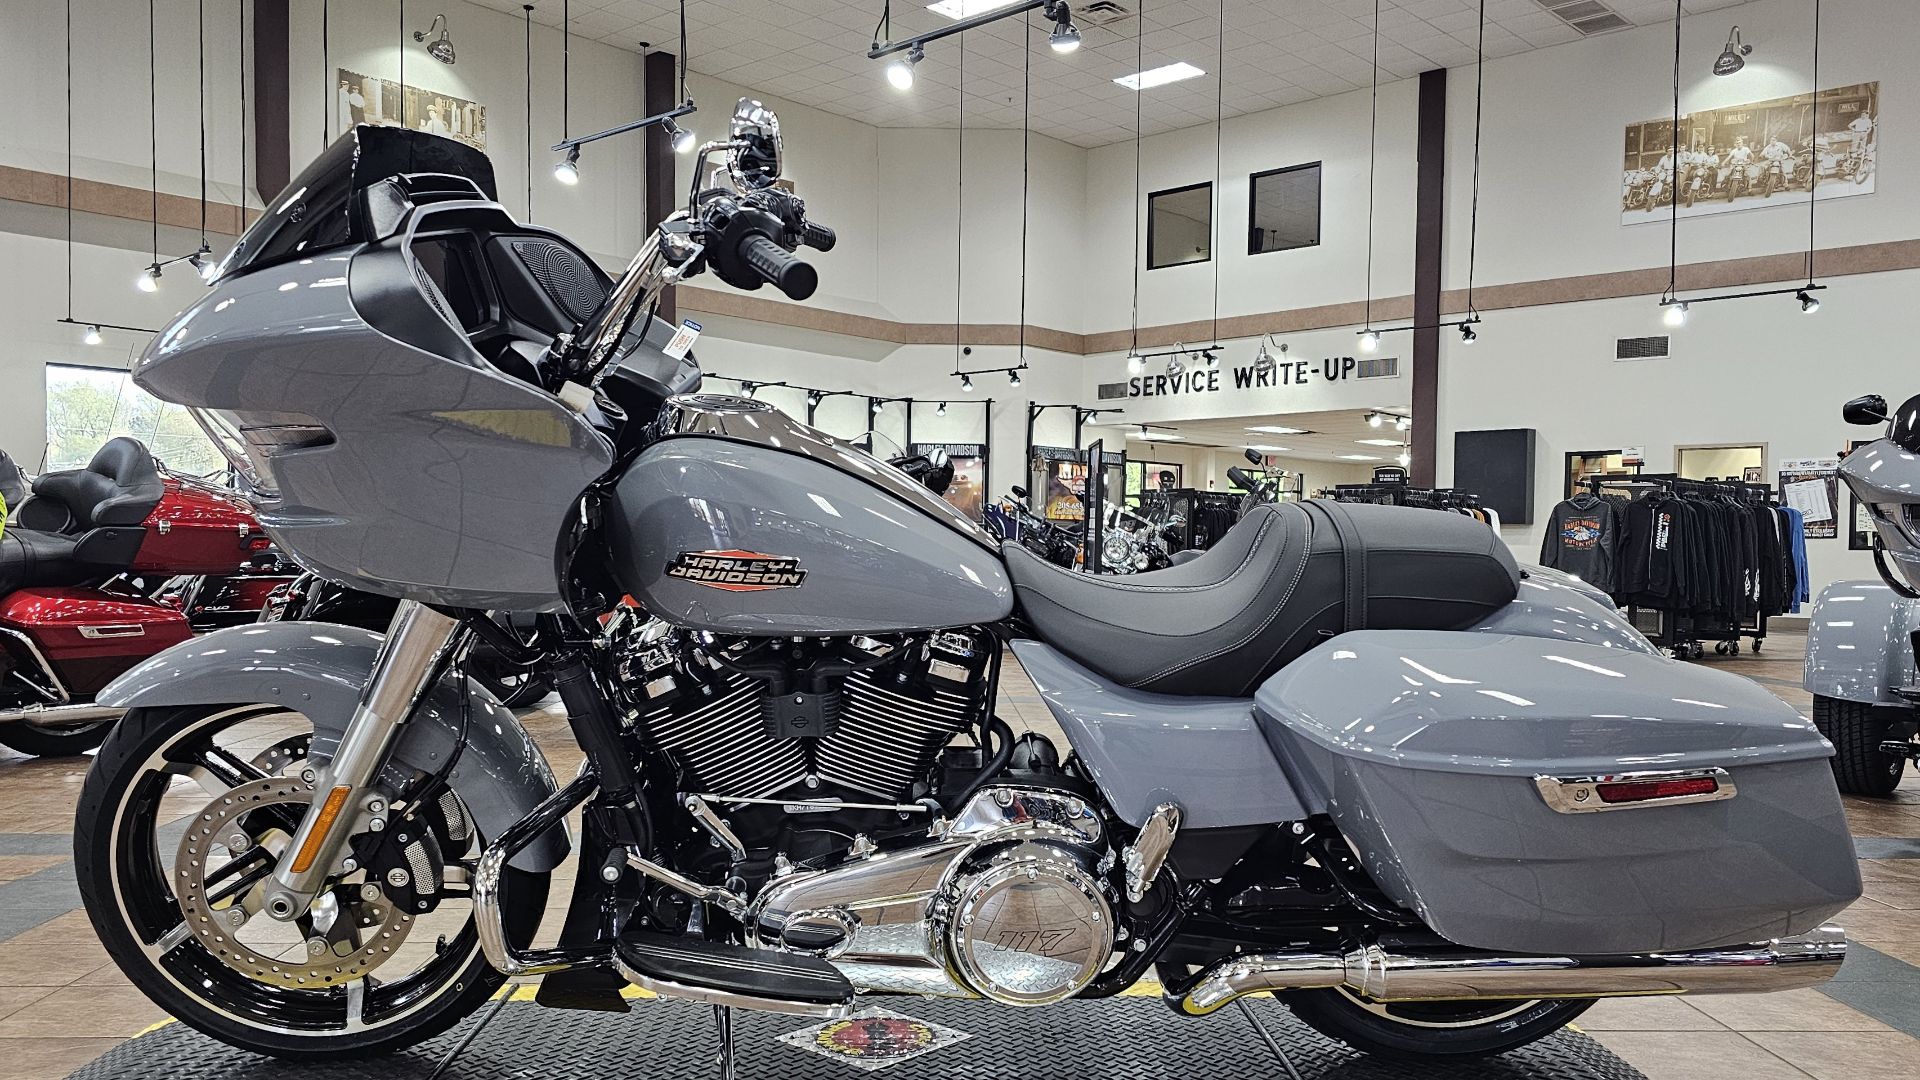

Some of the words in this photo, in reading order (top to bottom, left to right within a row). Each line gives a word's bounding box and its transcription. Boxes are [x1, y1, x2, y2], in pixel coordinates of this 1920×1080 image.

[1129, 369, 1220, 397] SERVICE
[1234, 357, 1356, 389] WRITE-UP
[685, 557, 793, 572] HARLEY-
[670, 567, 800, 584] DAVIDSON
[993, 928, 1076, 952] 117
